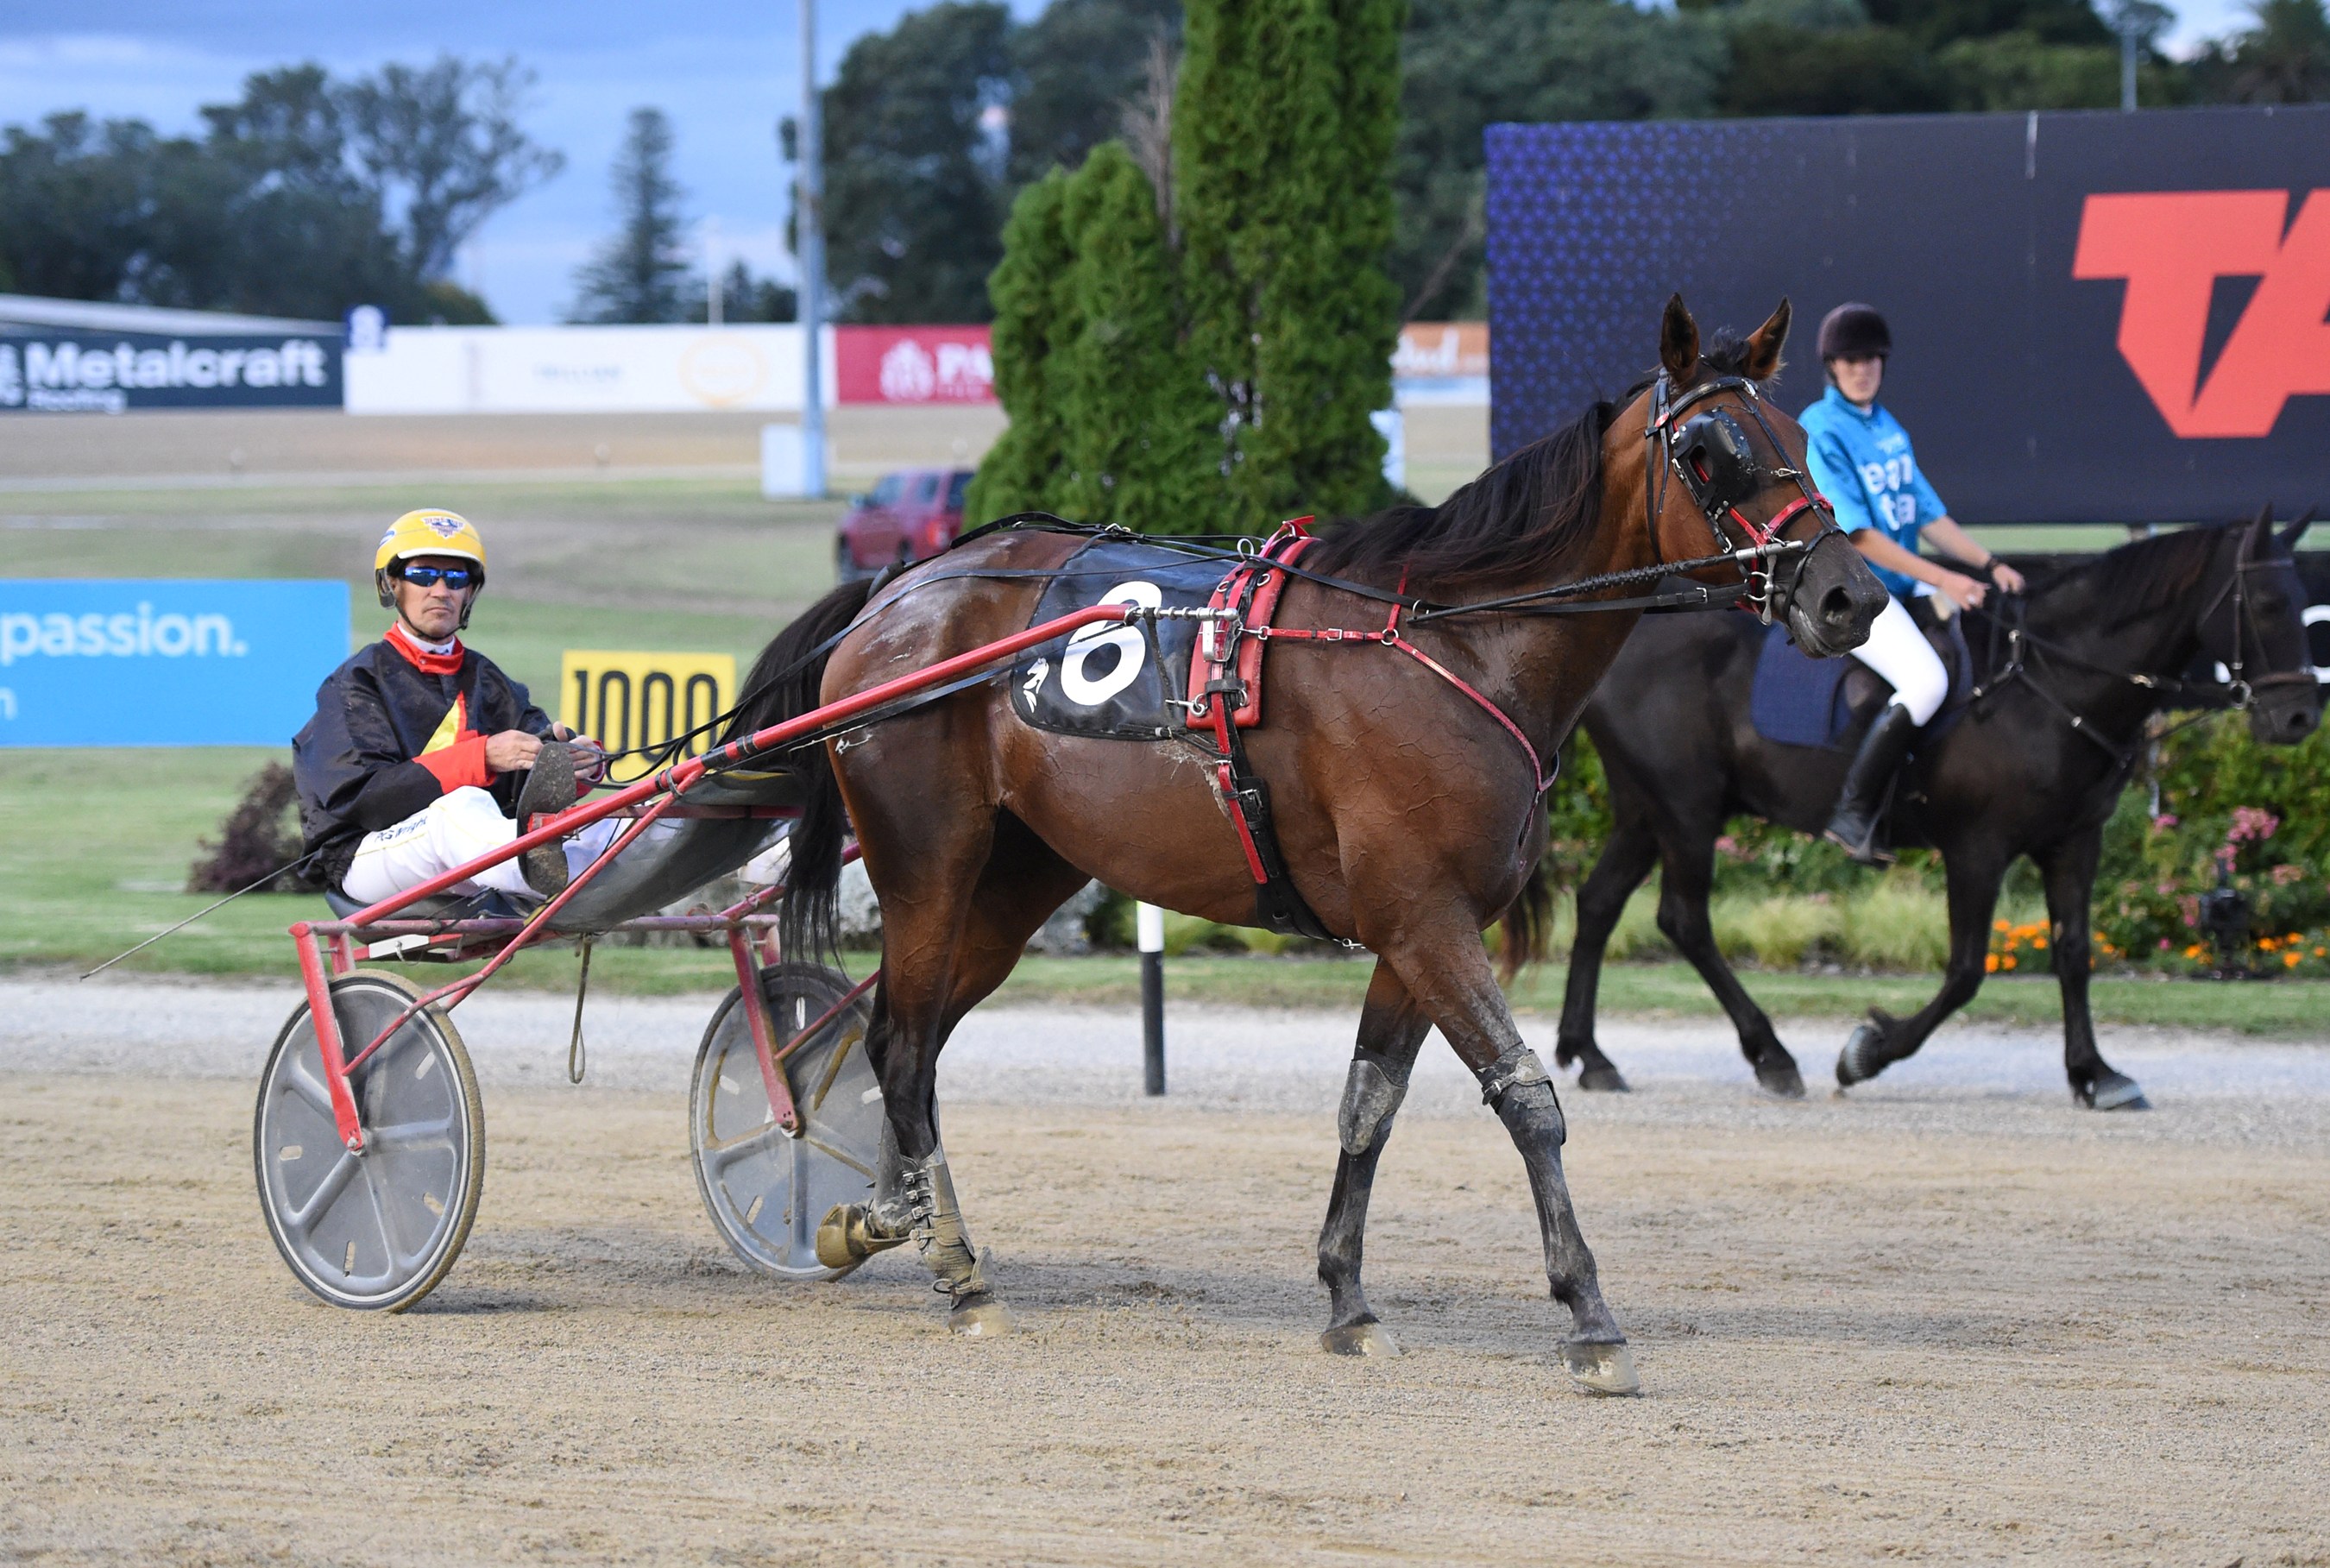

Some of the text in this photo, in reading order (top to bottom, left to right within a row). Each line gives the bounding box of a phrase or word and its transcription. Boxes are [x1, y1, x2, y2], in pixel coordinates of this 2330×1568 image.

[24, 340, 328, 389] Metalcraft
[1, 601, 250, 666] passion.
[1061, 581, 1162, 706] 6
[575, 670, 719, 764] 1000
